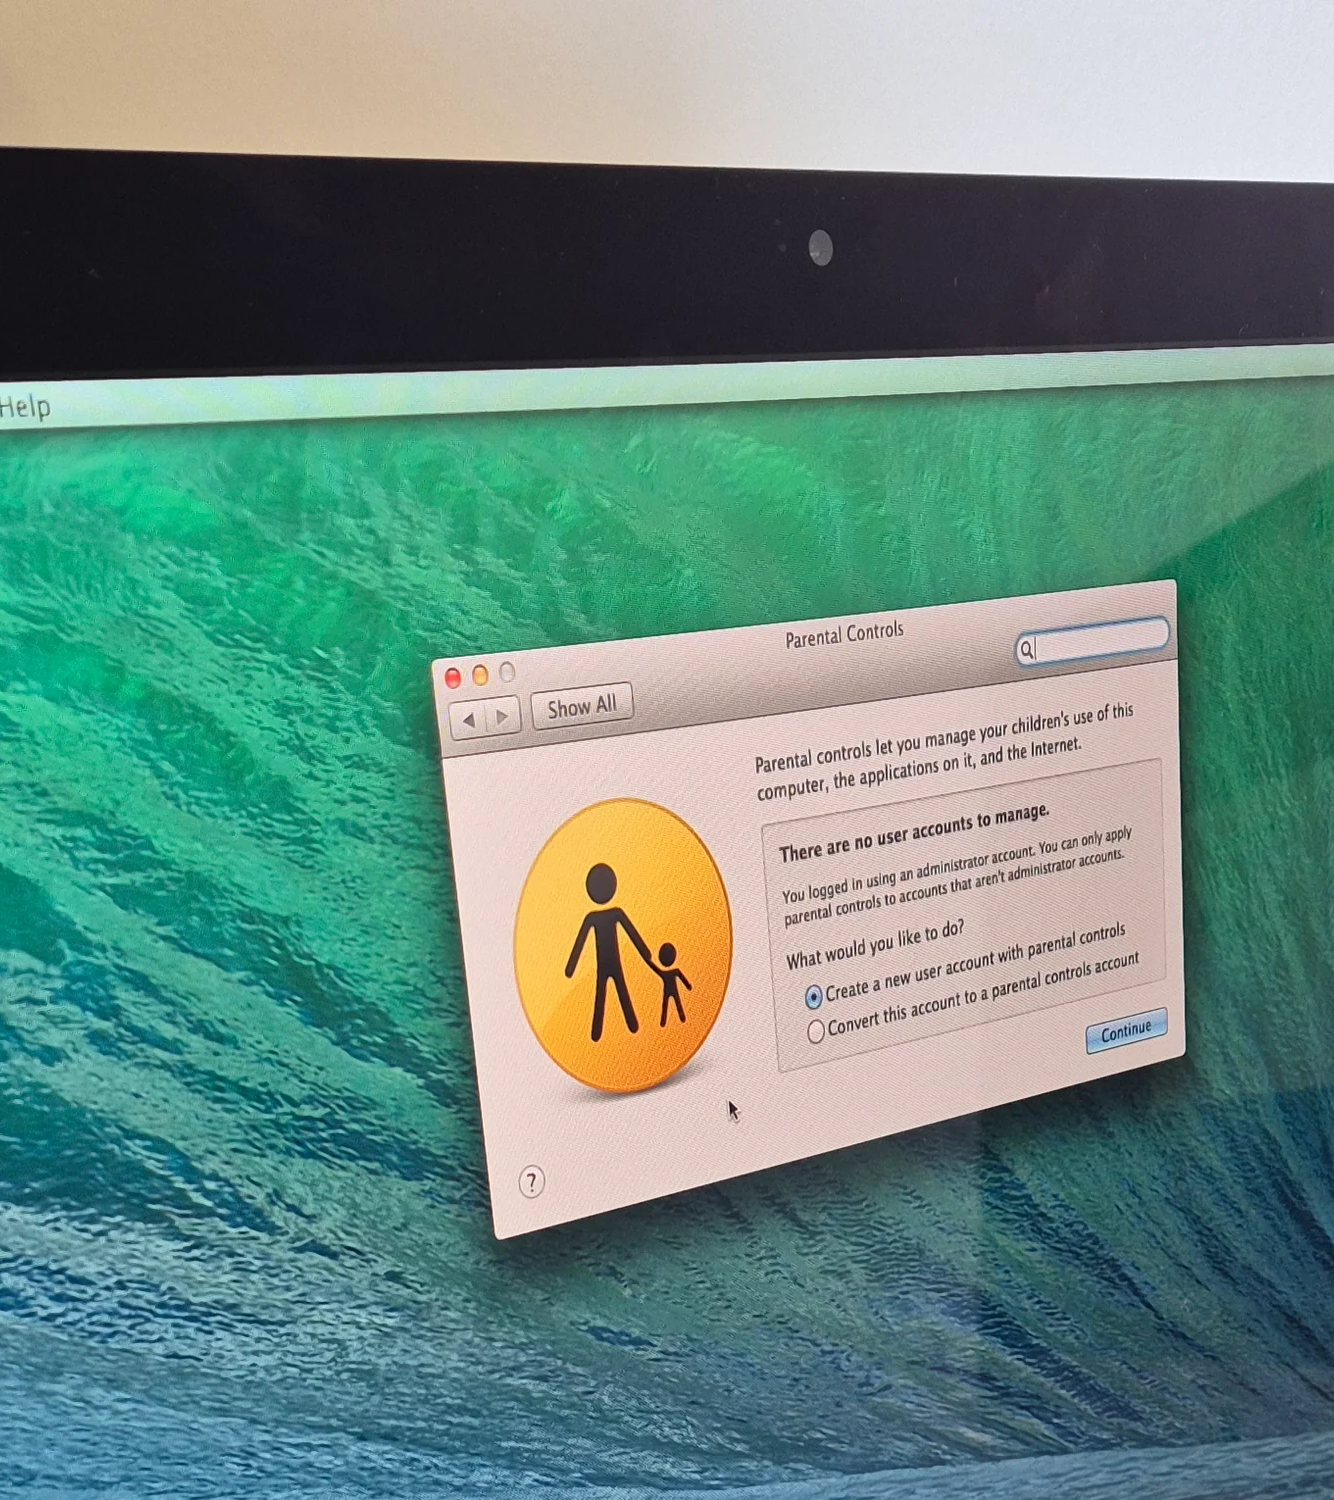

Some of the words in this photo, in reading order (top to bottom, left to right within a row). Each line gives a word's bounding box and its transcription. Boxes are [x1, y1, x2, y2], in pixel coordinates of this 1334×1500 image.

[785, 624, 842, 650] Parental
[847, 619, 905, 643] Controls
[548, 699, 591, 720] Show
[595, 693, 618, 715] All
[755, 748, 812, 774] Parental
[817, 741, 872, 765] controls
[876, 738, 893, 756] let
[896, 736, 921, 757] you
[925, 727, 976, 748] manage
[979, 723, 1008, 743] your
[1012, 710, 1070, 735] children's
[1073, 710, 1093, 725] use
[1097, 703, 1110, 722] of
[1112, 702, 1134, 719] this
[757, 777, 830, 801] computer,
[833, 771, 856, 789] the
[859, 760, 939, 788] applications
[943, 757, 959, 772] on
[963, 752, 977, 770] it,
[980, 745, 1003, 766] and
[1007, 744, 1028, 761] the
[1031, 736, 1082, 758] Internet.
[779, 843, 823, 864] There
[827, 839, 850, 855] are
[854, 835, 873, 850] no
[877, 829, 909, 846] user
[912, 816, 973, 840] accounts
[977, 813, 991, 828] to
[995, 804, 1050, 825] manage.
[782, 889, 805, 905] You
[808, 878, 848, 900] logged
[852, 877, 863, 891] in
[866, 871, 896, 888] using
[900, 869, 914, 882] an
[916, 853, 989, 879] administrator
[992, 845, 1036, 864] account.
[1039, 840, 1058, 855] You
[1061, 837, 1079, 850] can
[1081, 830, 1103, 846] only
[1105, 825, 1132, 843] apply
[784, 903, 832, 929] parental
[836, 894, 882, 916] controls
[884, 893, 896, 906] to
[899, 883, 948, 903] accounts
[950, 877, 972, 893] that
[975, 870, 1005, 888] aren't
[1007, 858, 1076, 882] administrator
[1079, 848, 1125, 867] accounts.
[786, 950, 822, 971] What
[825, 938, 866, 962] would
[869, 937, 894, 957] you
[898, 929, 922, 947] like
[925, 926, 938, 942] to
[942, 918, 965, 938] do?
[826, 981, 869, 1002] Create
[873, 979, 881, 992] a
[885, 972, 911, 989] new
[915, 965, 943, 983] user
[946, 952, 995, 976] account
[998, 943, 1024, 963] with
[1028, 931, 1076, 961] parental
[1079, 921, 1126, 945] controls
[828, 1011, 880, 1036] Convert
[883, 1005, 907, 1024] this
[911, 993, 961, 1018] account
[964, 990, 977, 1005] to
[981, 988, 988, 1001] a
[992, 971, 1041, 1002] parental
[1045, 961, 1092, 985] controls
[1095, 951, 1140, 974] account
[1101, 1019, 1152, 1043] Continue
[526, 1172, 536, 1193] ?
